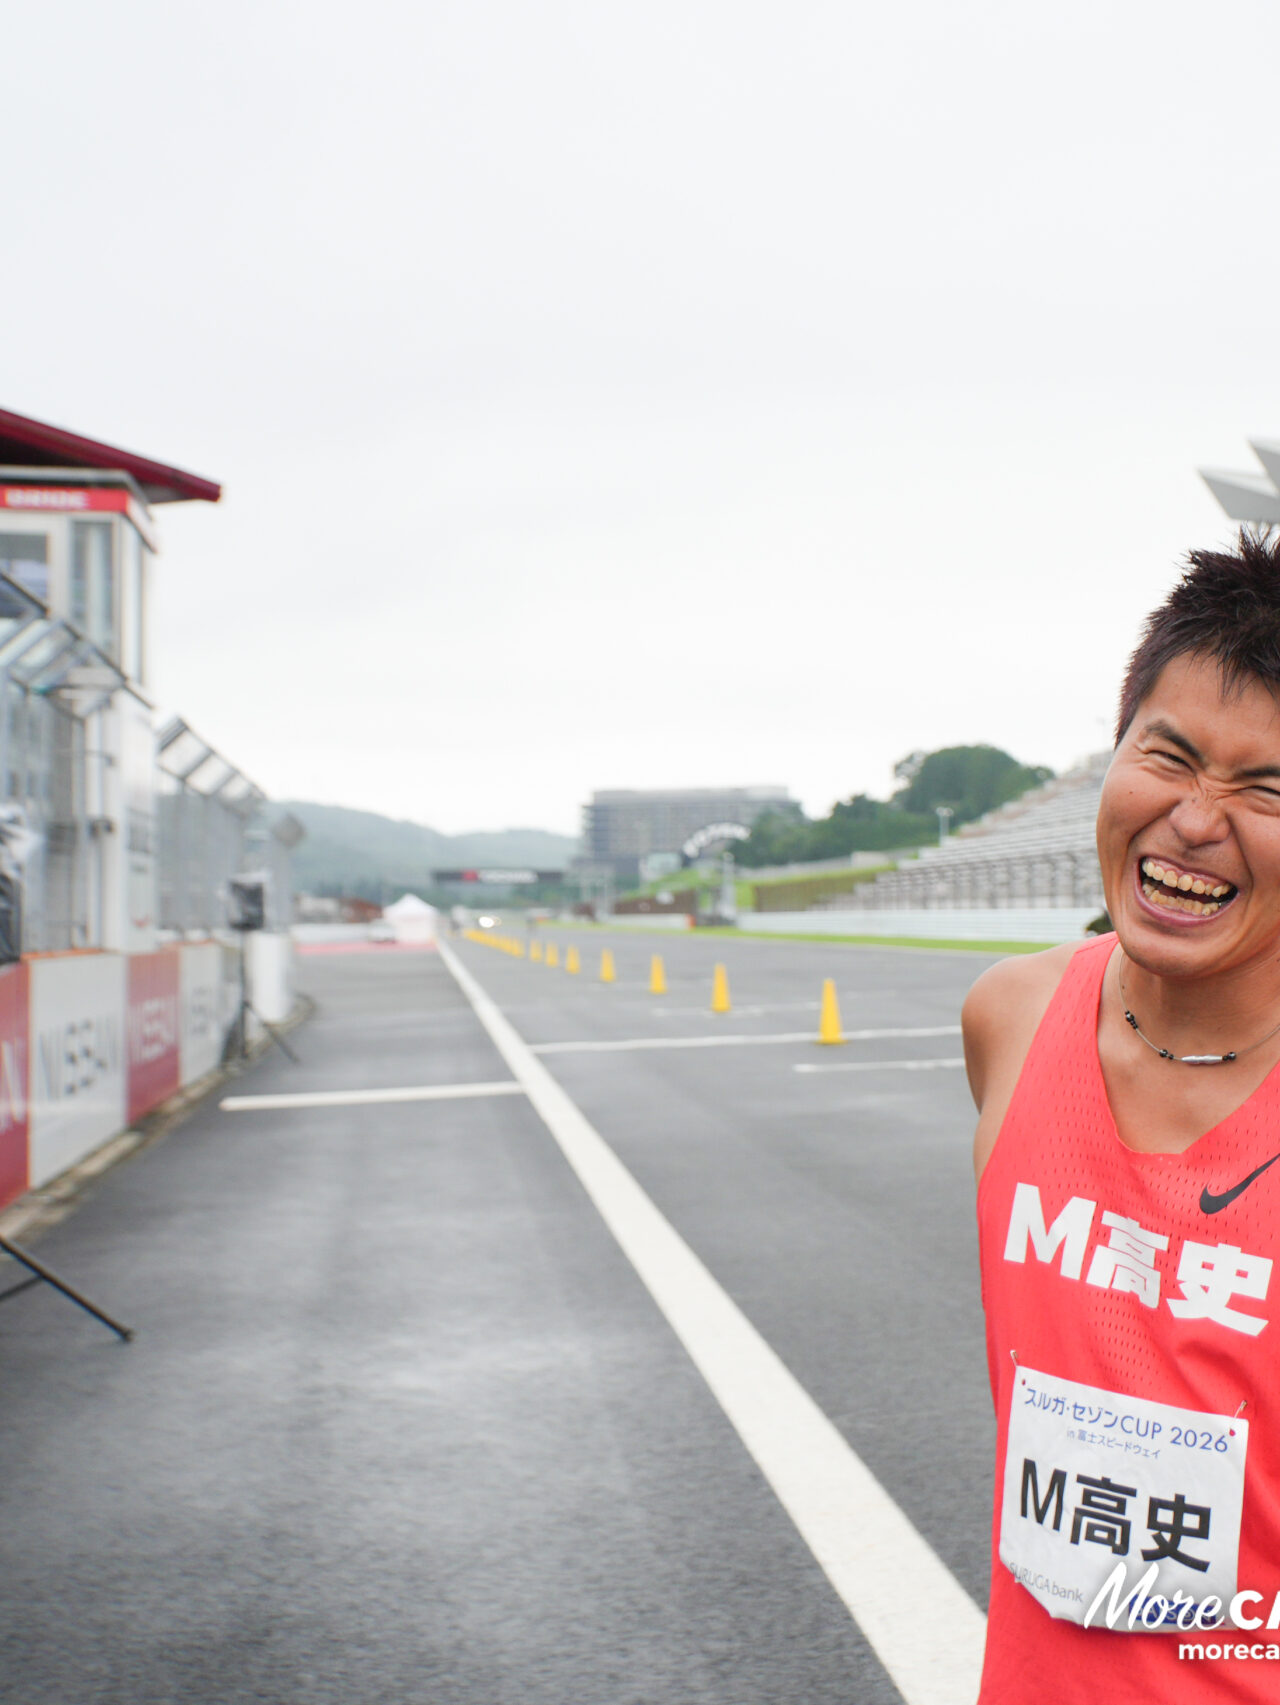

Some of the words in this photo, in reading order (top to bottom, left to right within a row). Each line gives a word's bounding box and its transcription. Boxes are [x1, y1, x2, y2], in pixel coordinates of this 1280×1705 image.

[1003, 1181, 1273, 1337] M高史
[1077, 1429, 1162, 1459] 富士スピードウェイ
[1170, 1426, 1229, 1453] 2026
[1020, 1457, 1212, 1573] M高史
[1051, 1581, 1085, 1602] bank
